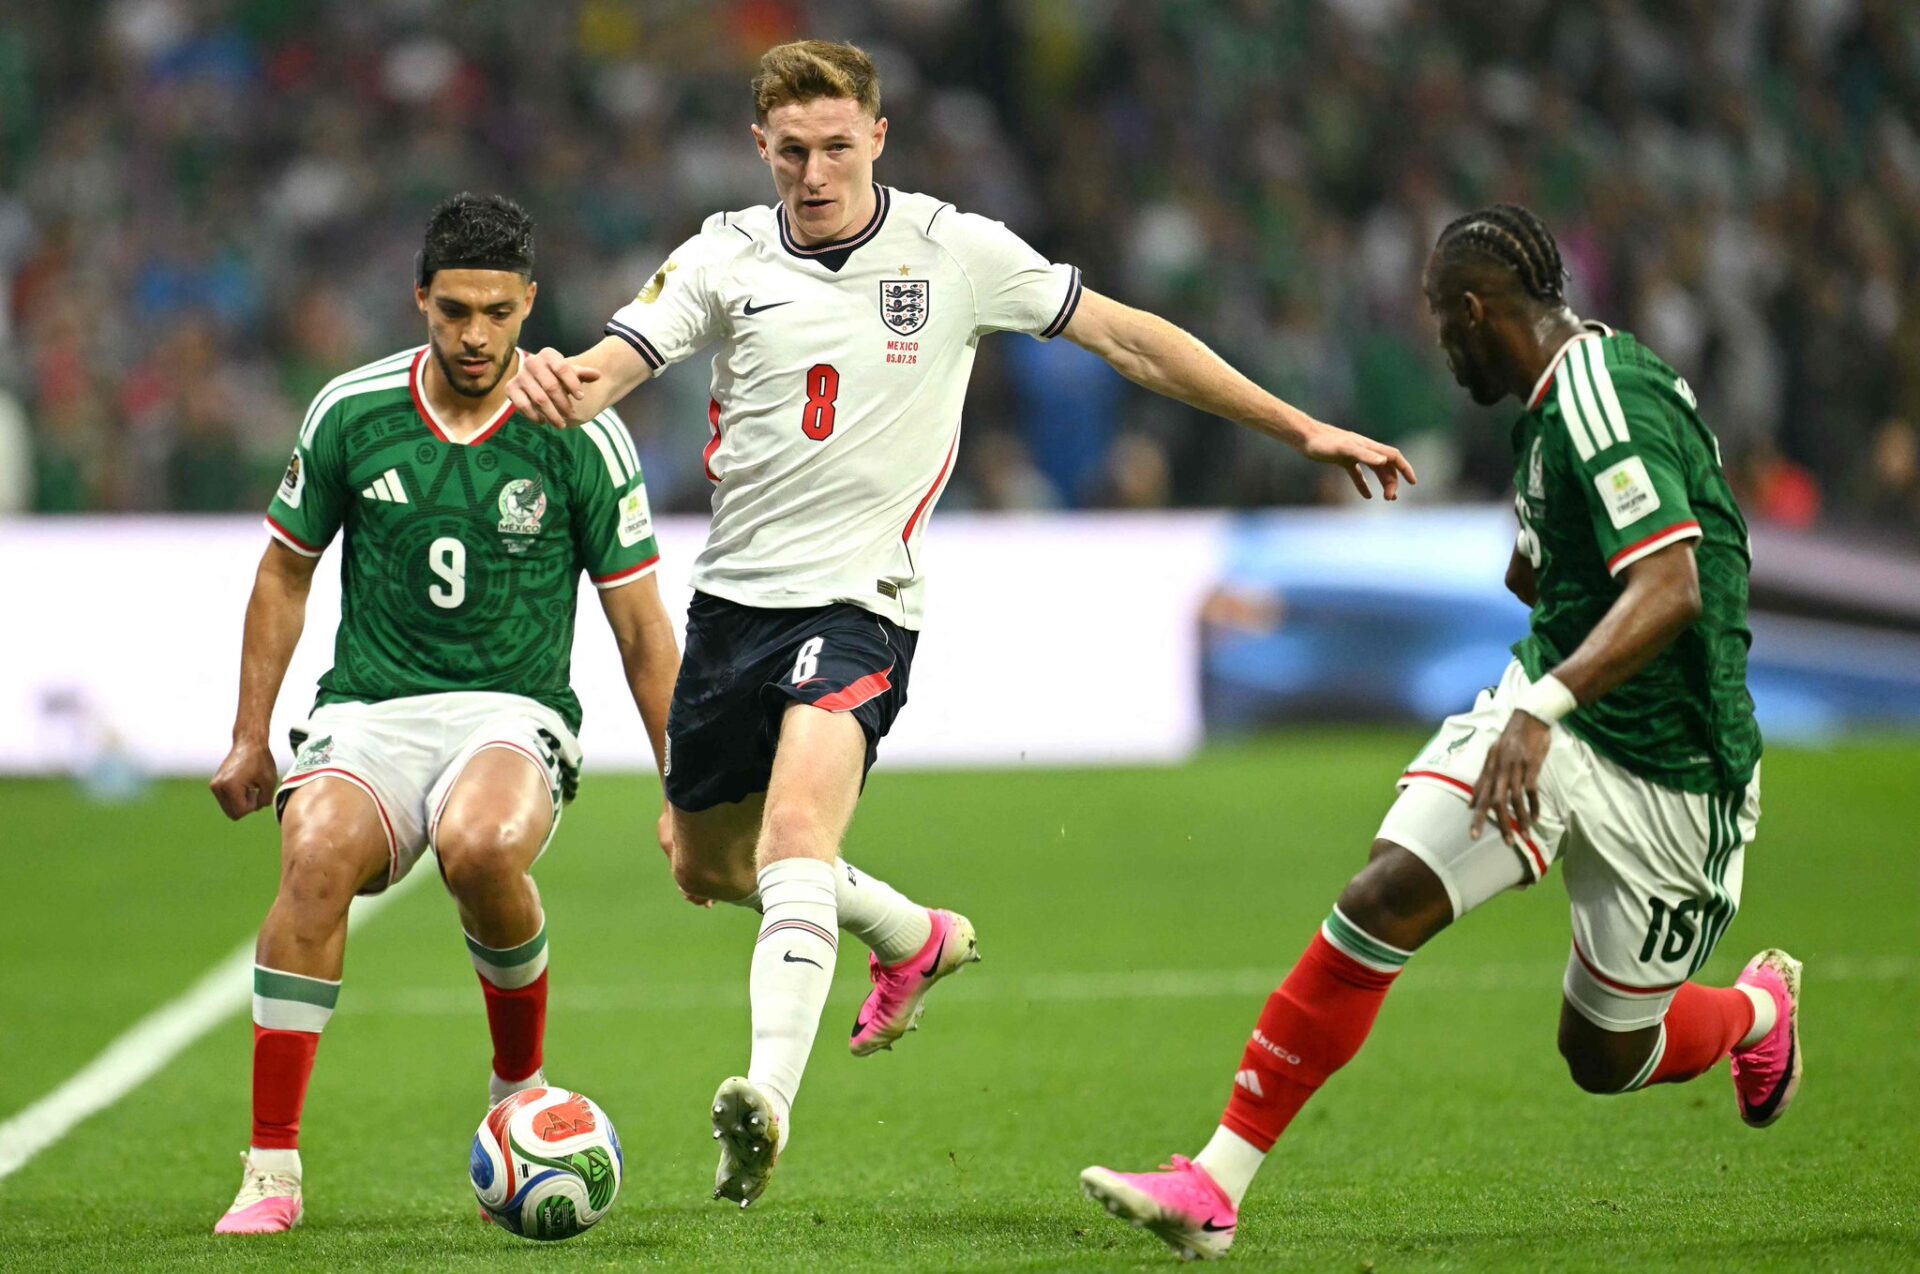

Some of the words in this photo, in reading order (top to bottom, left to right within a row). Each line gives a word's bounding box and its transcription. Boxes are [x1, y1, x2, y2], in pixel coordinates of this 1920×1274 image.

[886, 354, 917, 365] 05.07.26
[887, 341, 919, 351] MEXICO
[802, 364, 840, 442] 8
[428, 537, 466, 609] 9
[791, 636, 824, 684] 8
[1639, 897, 1698, 963] 16
